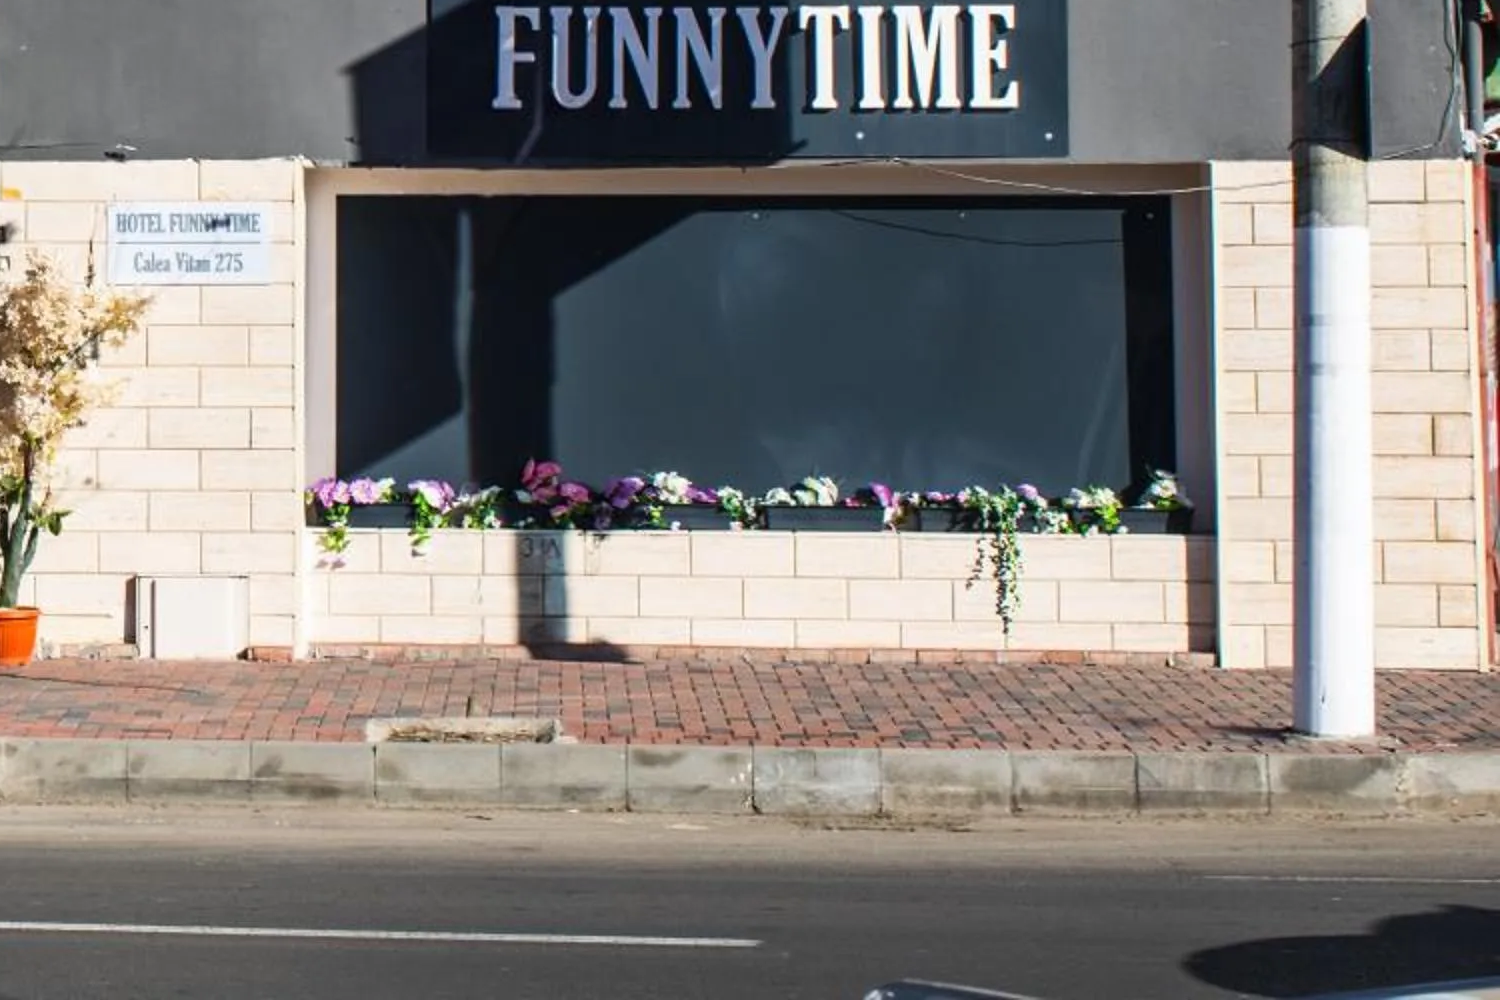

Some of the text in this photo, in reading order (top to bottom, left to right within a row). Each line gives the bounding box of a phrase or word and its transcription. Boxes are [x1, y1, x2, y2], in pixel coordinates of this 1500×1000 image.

[116, 213, 166, 233] HOTEL
[133, 252, 172, 273] Calea
[215, 252, 244, 273] 275
